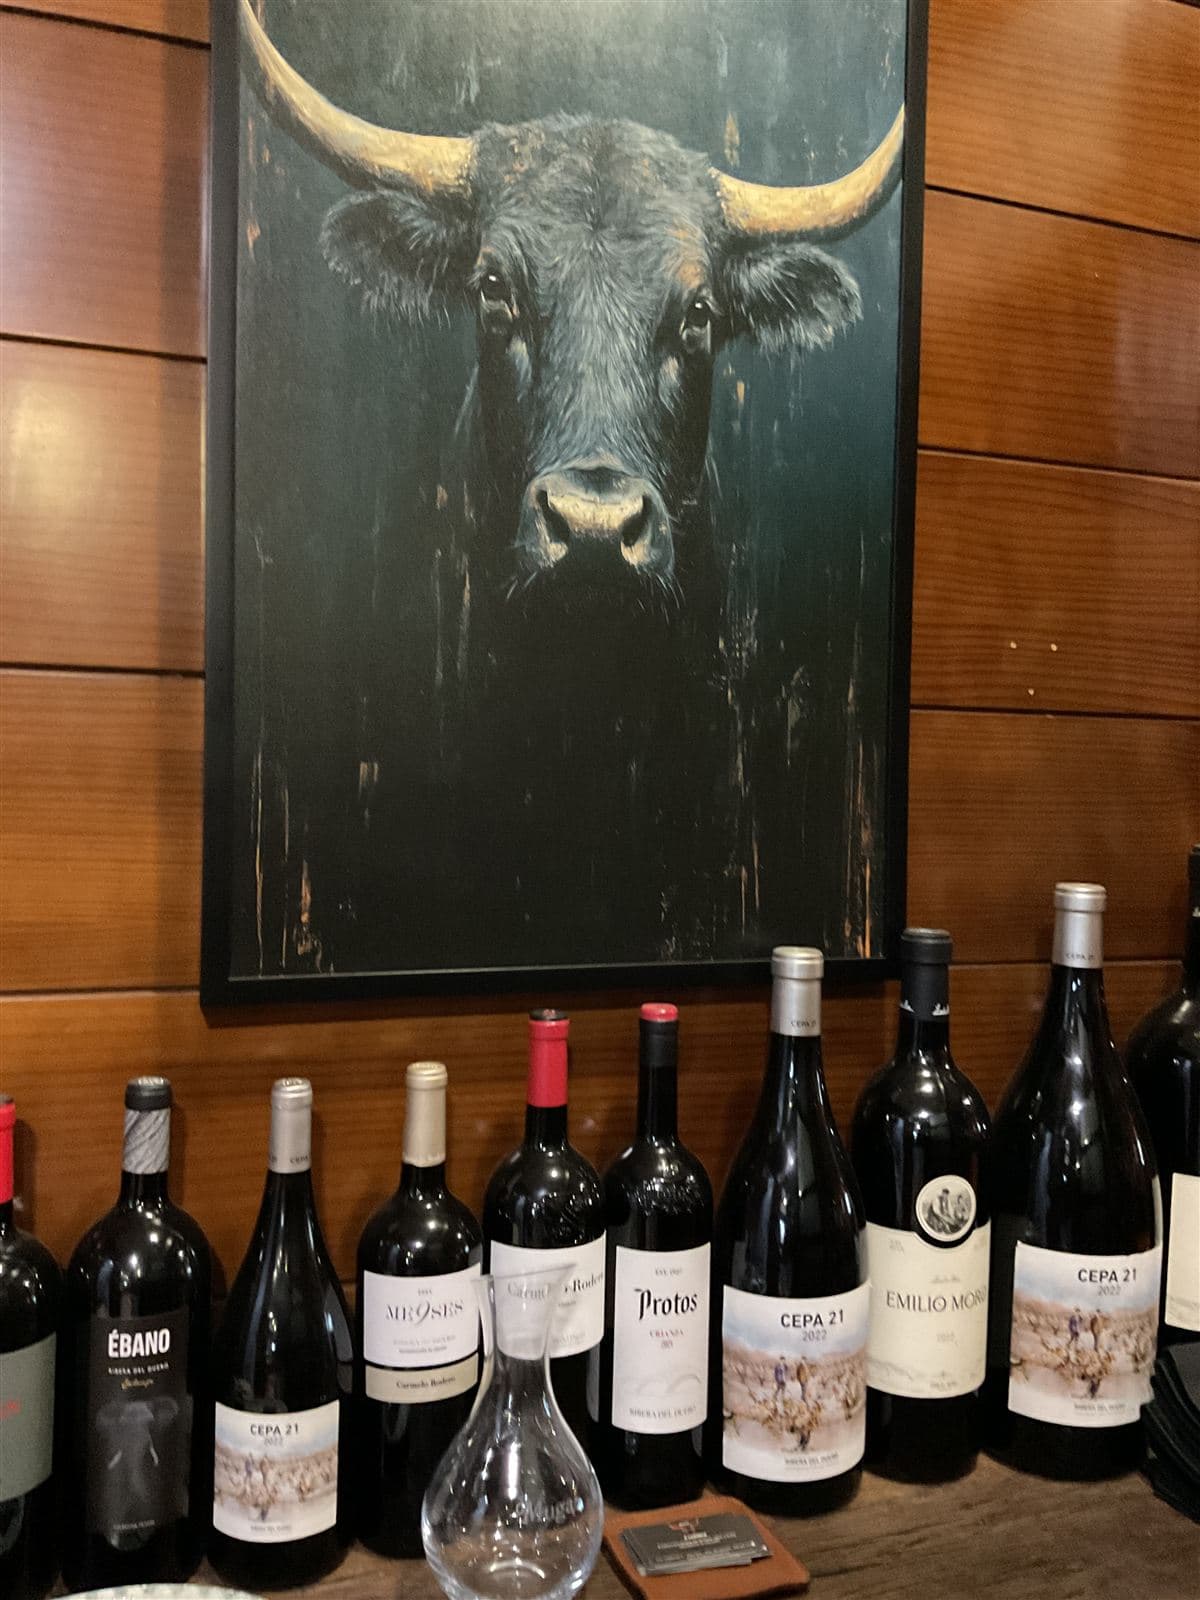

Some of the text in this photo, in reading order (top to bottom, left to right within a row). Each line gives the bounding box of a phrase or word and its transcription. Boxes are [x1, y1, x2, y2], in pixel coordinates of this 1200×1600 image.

[1078, 1268, 1136, 1283] CEPA 21
[634, 1289, 698, 1321] Protos
[886, 1289, 947, 1312] EMILIO
[780, 1308, 844, 1328] CEPA 21
[108, 1328, 171, 1358] ÉBANO
[802, 1329, 827, 1341] 2022
[250, 1423, 298, 1436] CEPA 21
